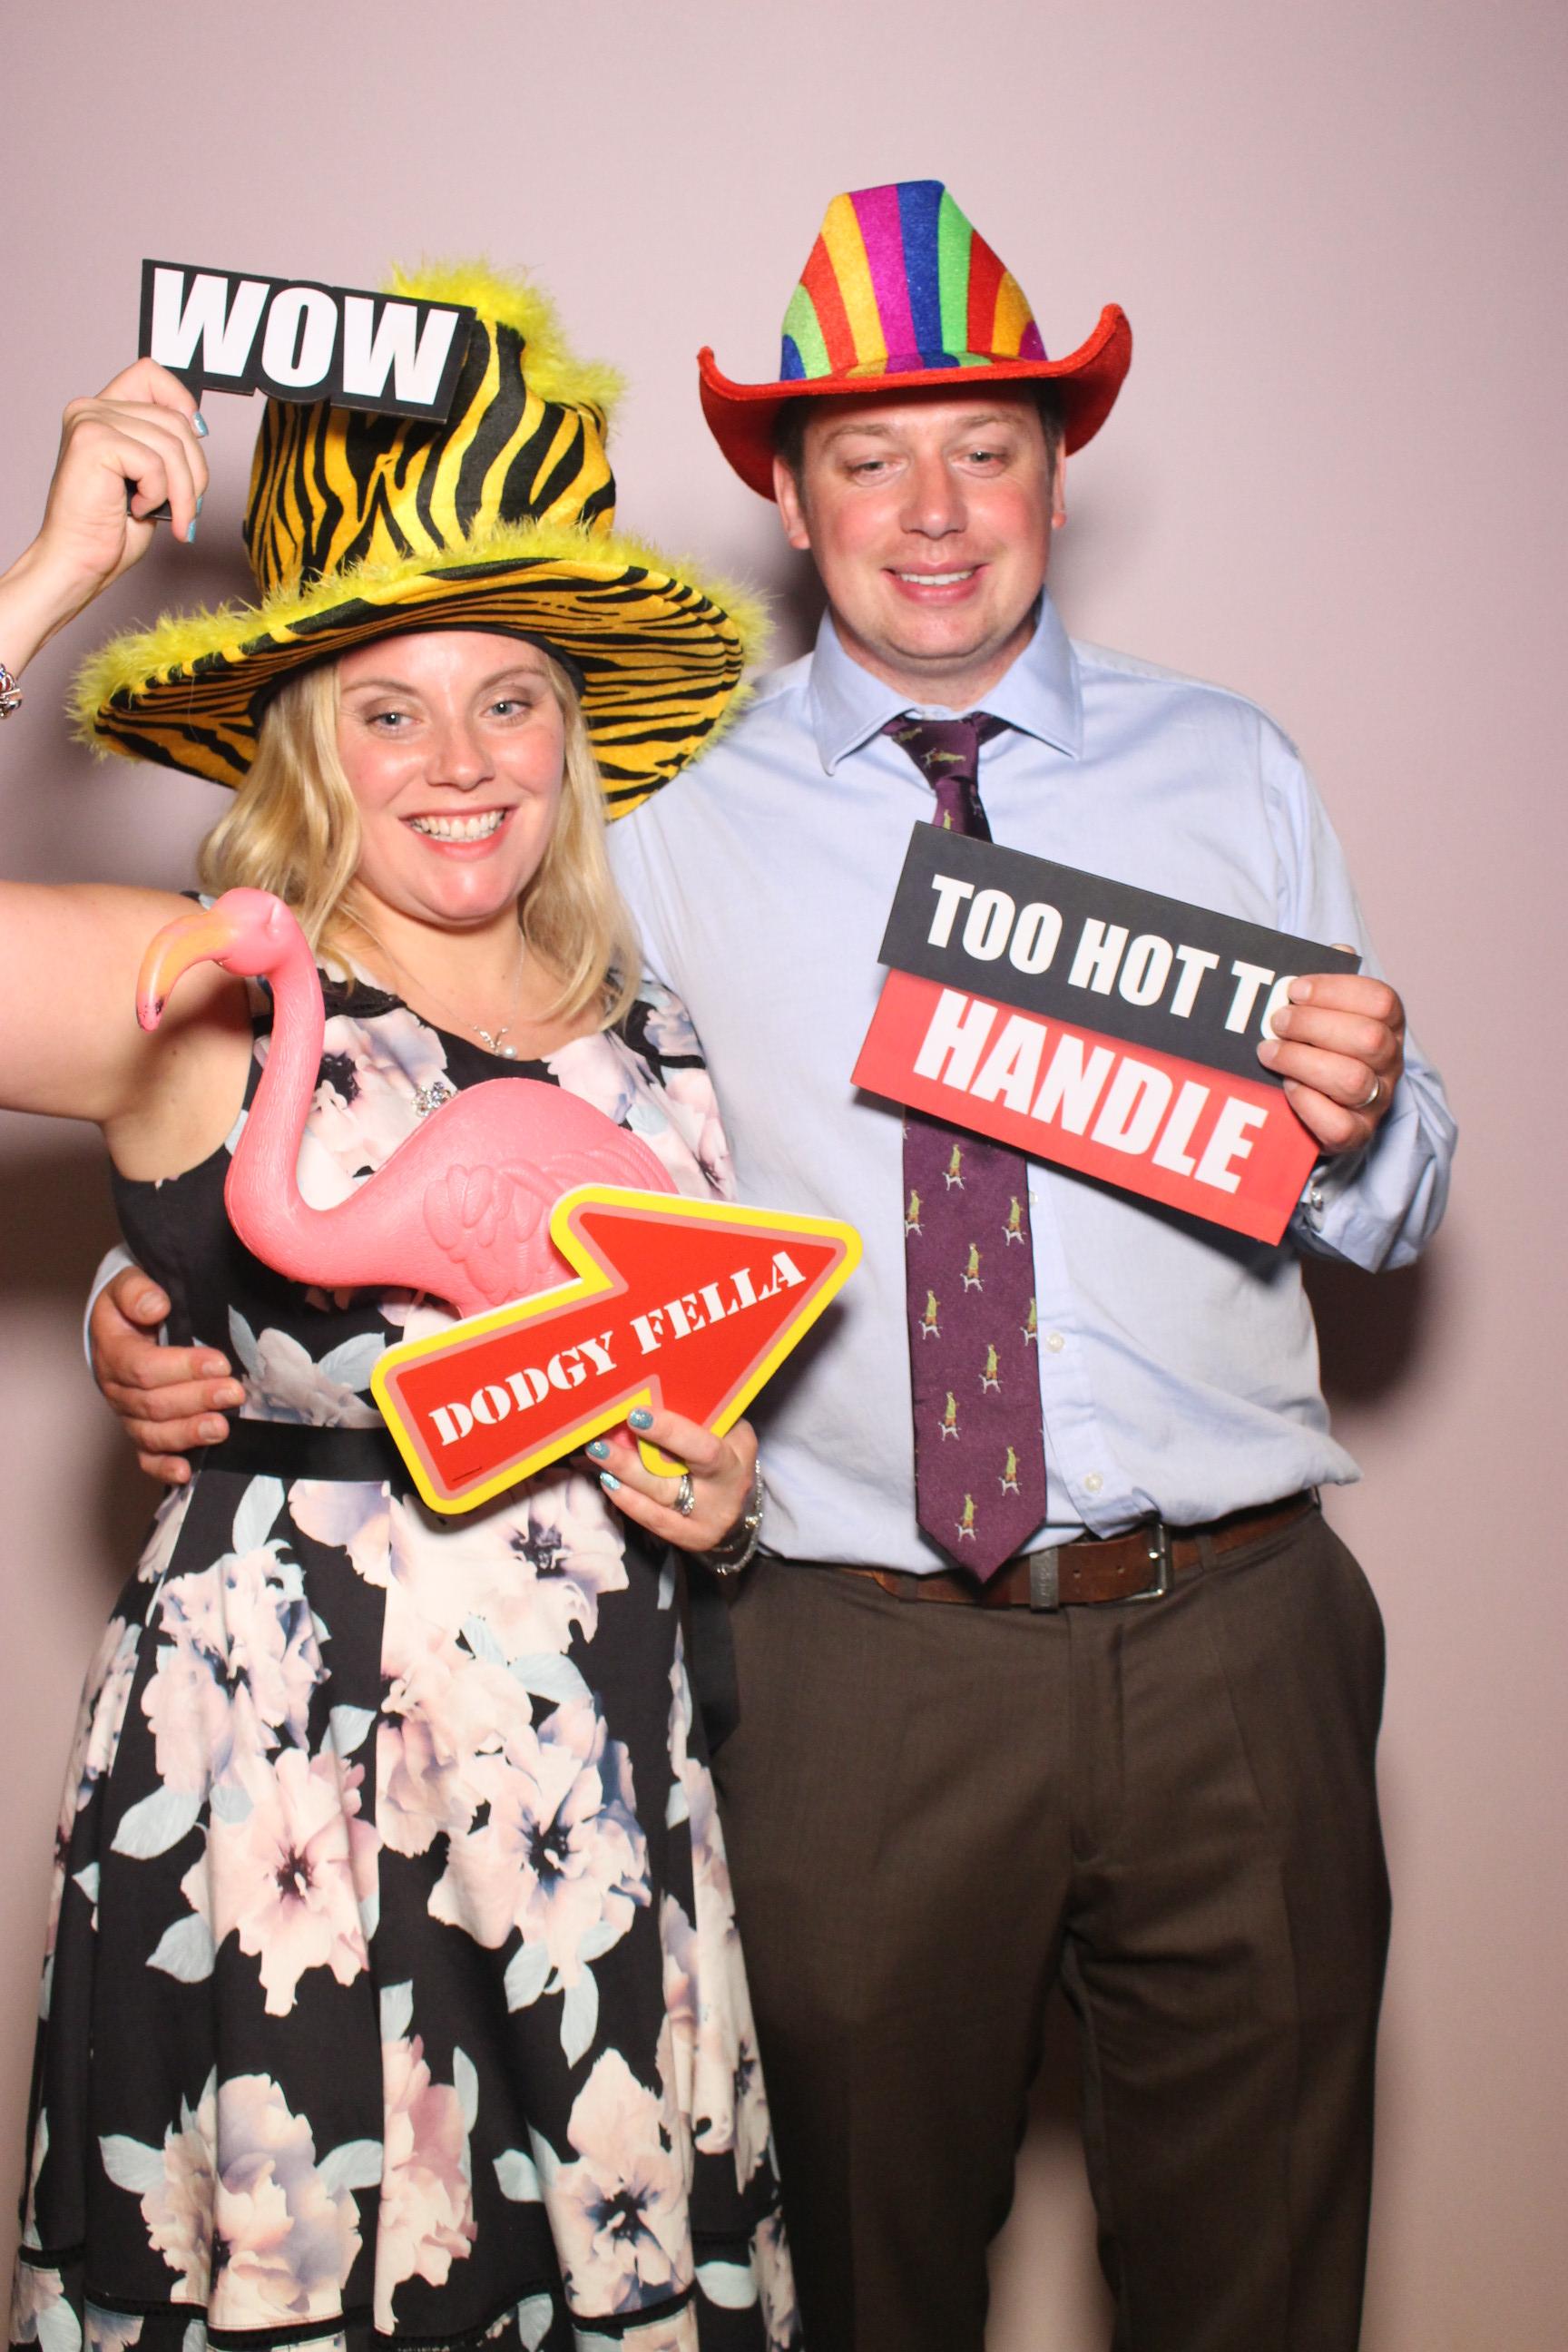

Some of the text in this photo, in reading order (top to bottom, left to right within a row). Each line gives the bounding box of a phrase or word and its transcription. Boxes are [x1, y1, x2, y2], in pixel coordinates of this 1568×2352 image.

[151, 268, 459, 405] WOW
[926, 874, 1063, 975] TOO
[1067, 917, 1220, 1018] HOT
[913, 988, 1269, 1194] HANDLE
[428, 1251, 807, 1446] DODGY FELLA
